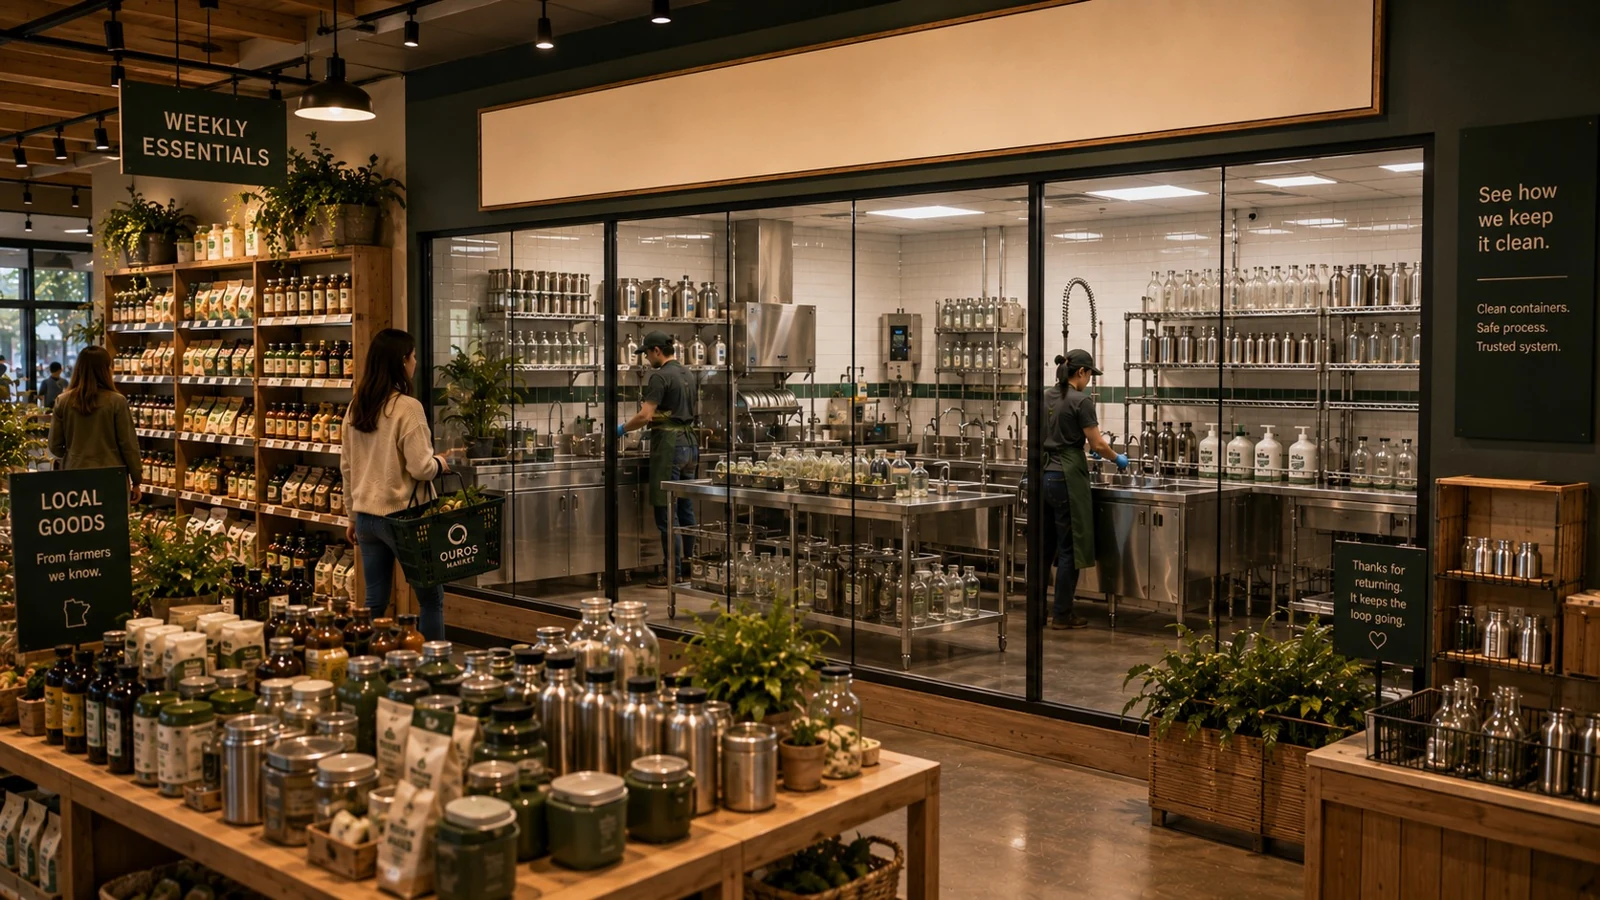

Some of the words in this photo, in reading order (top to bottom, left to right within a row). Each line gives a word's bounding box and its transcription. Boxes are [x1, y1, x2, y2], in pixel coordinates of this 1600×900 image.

[163, 111, 248, 138] WEEKLY
[143, 136, 270, 167] ESSENTIALS
[1478, 186, 1513, 204] See
[1518, 183, 1558, 201] how
[1478, 213, 1504, 228] we
[1509, 208, 1554, 229] keep
[1478, 235, 1490, 253] it
[1495, 233, 1550, 252] clean.
[1476, 303, 1507, 315] Clean
[1509, 301, 1570, 314] containers.
[1476, 321, 1500, 334] Safe
[1503, 323, 1549, 336] process.
[1476, 340, 1516, 352] Trusted
[1519, 340, 1561, 355] system.
[41, 489, 103, 511] LOCAL
[38, 513, 106, 537] GOODS
[36, 552, 66, 565] From
[69, 548, 112, 562] farmers
[440, 544, 479, 562] OUROS
[49, 572, 66, 582] we
[68, 567, 102, 580] know.
[1352, 560, 1388, 574] Thanks
[1391, 563, 1406, 575] for
[1355, 578, 1403, 594] returning.
[1350, 592, 1357, 603] It
[1360, 593, 1388, 608] keeps
[1390, 597, 1407, 609] the
[1350, 608, 1372, 623] loop
[1375, 613, 1406, 628] going.
